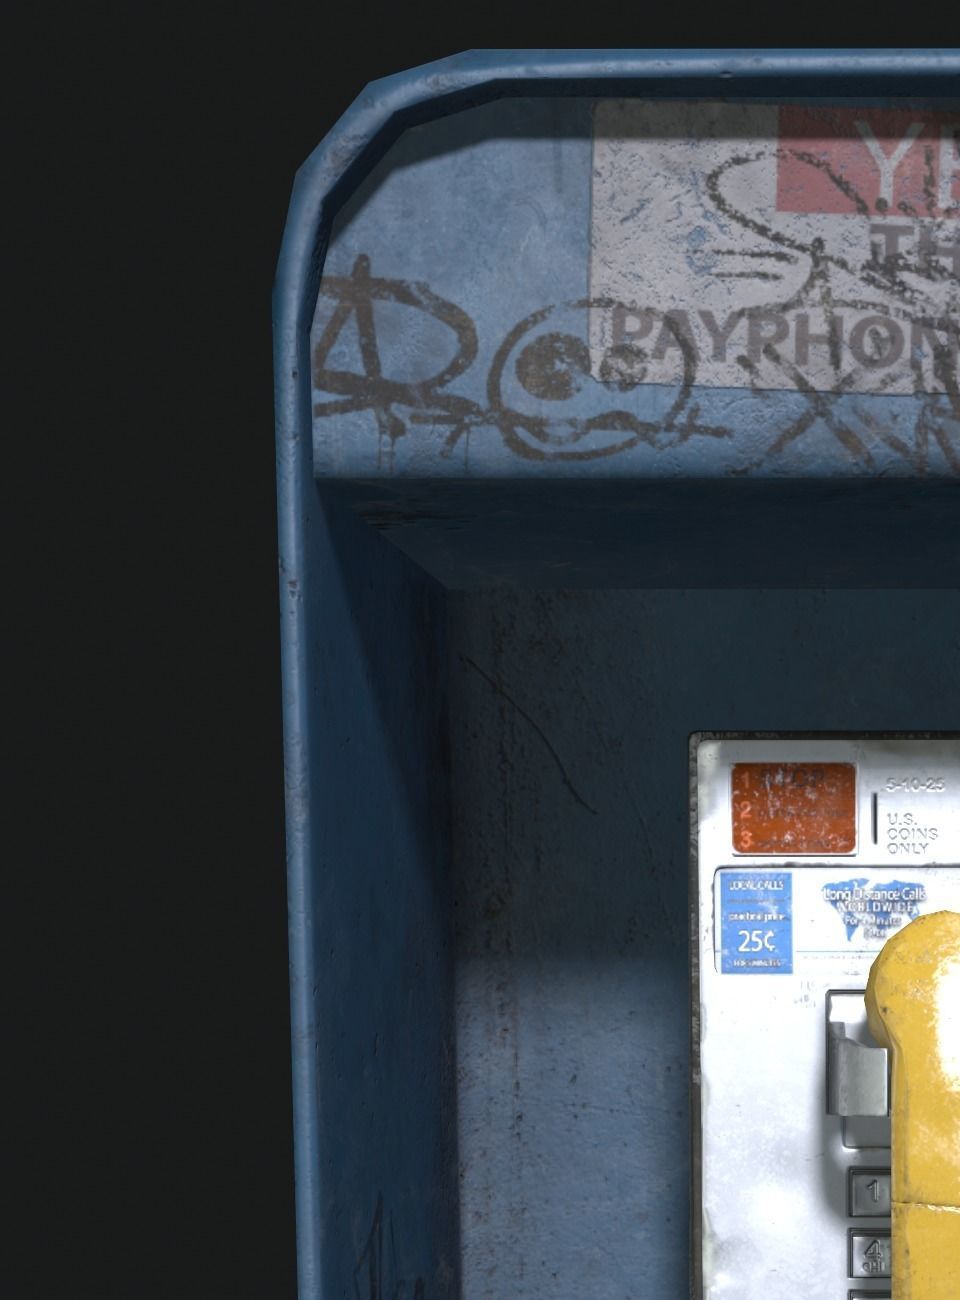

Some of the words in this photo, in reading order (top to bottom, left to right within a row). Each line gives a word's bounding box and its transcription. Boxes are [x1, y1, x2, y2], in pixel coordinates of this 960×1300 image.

[886, 776, 946, 793] 5-10-25
[740, 801, 753, 819] 2
[886, 812, 918, 826] U.S.
[740, 831, 753, 849] 3
[886, 827, 939, 841] COINS
[886, 842, 929, 855] ONLY
[823, 886, 851, 901] Long
[902, 886, 927, 901] Calls
[737, 929, 776, 953] 25¢
[866, 1178, 880, 1203] 1
[863, 1239, 883, 1262] 4
